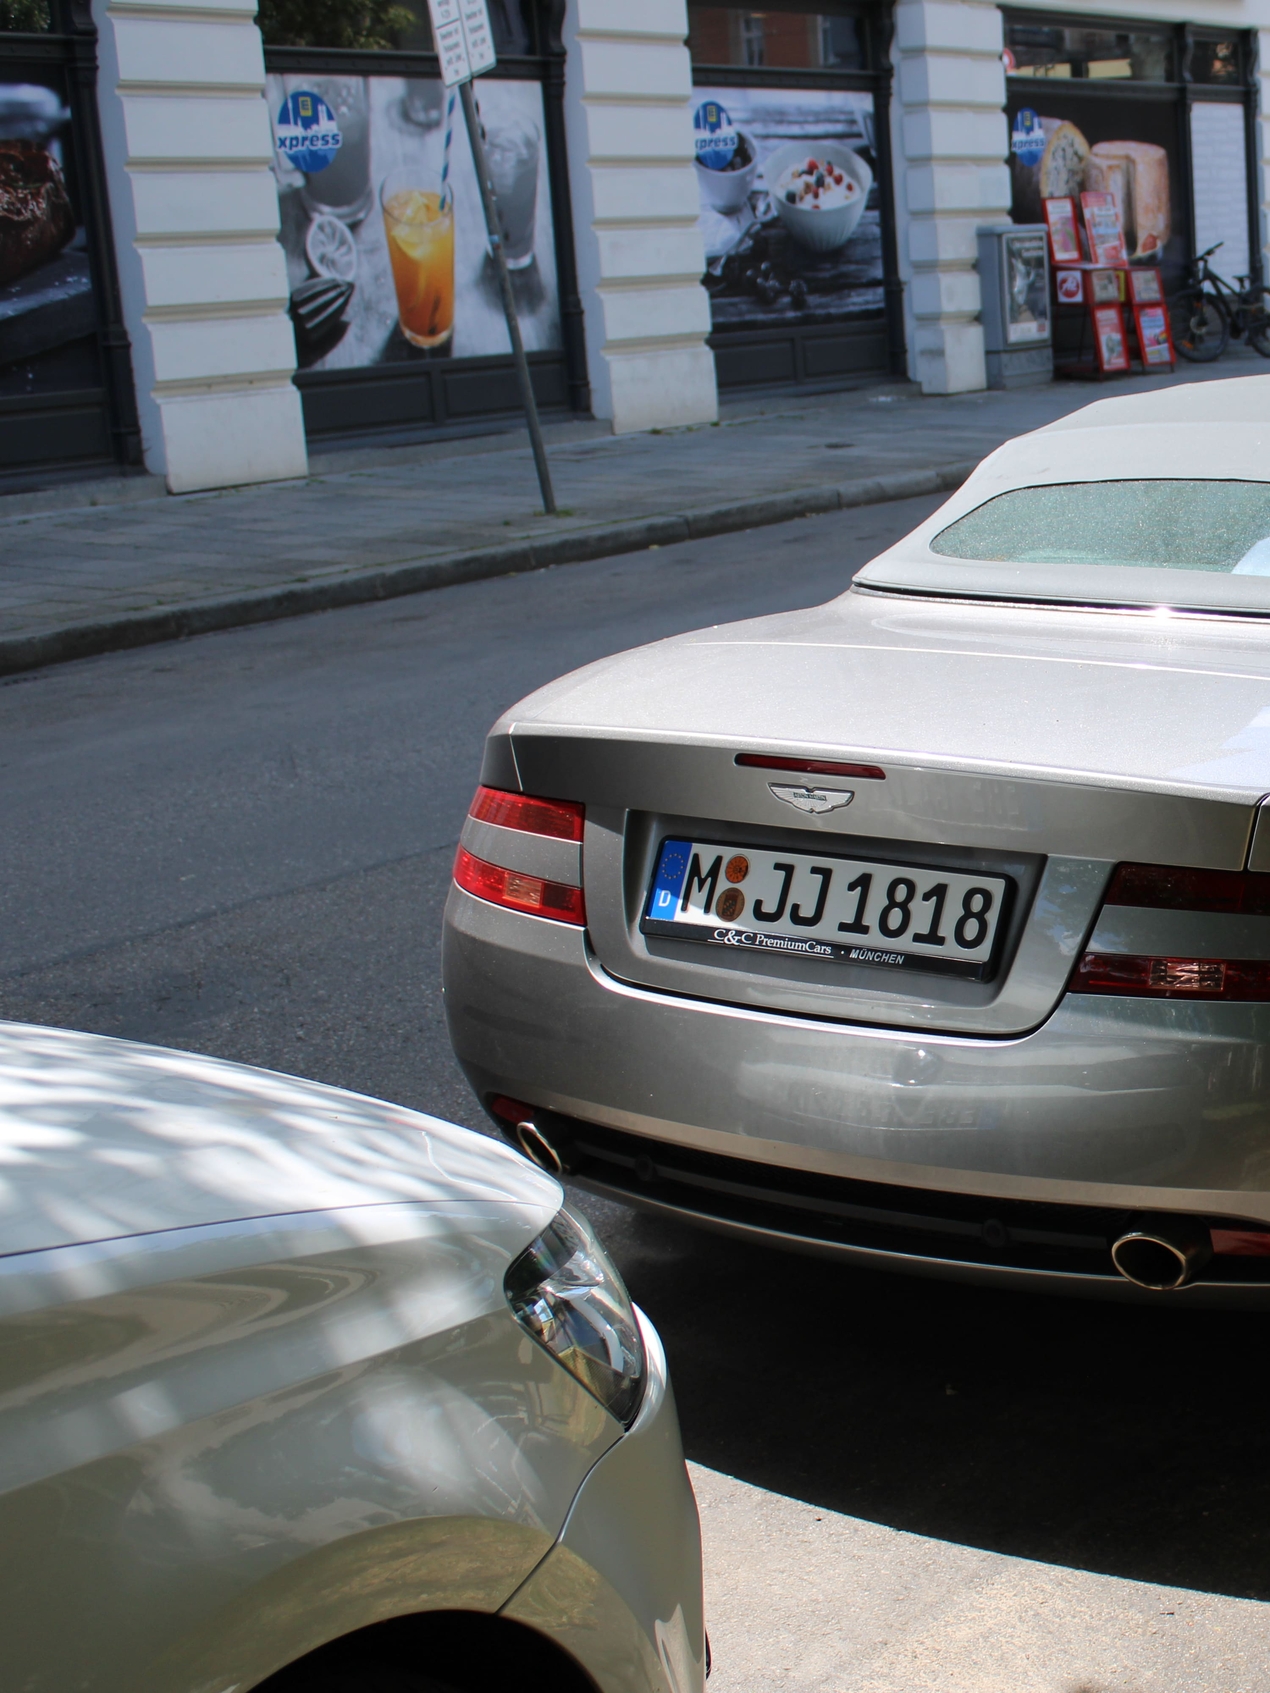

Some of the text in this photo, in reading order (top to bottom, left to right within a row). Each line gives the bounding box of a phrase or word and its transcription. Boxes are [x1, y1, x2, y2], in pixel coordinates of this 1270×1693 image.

[278, 133, 340, 151] xpress
[658, 889, 671, 907] D
[681, 853, 993, 950] M JJ 1818
[714, 929, 905, 965] C&C PremiumCars MÜNCHEN
